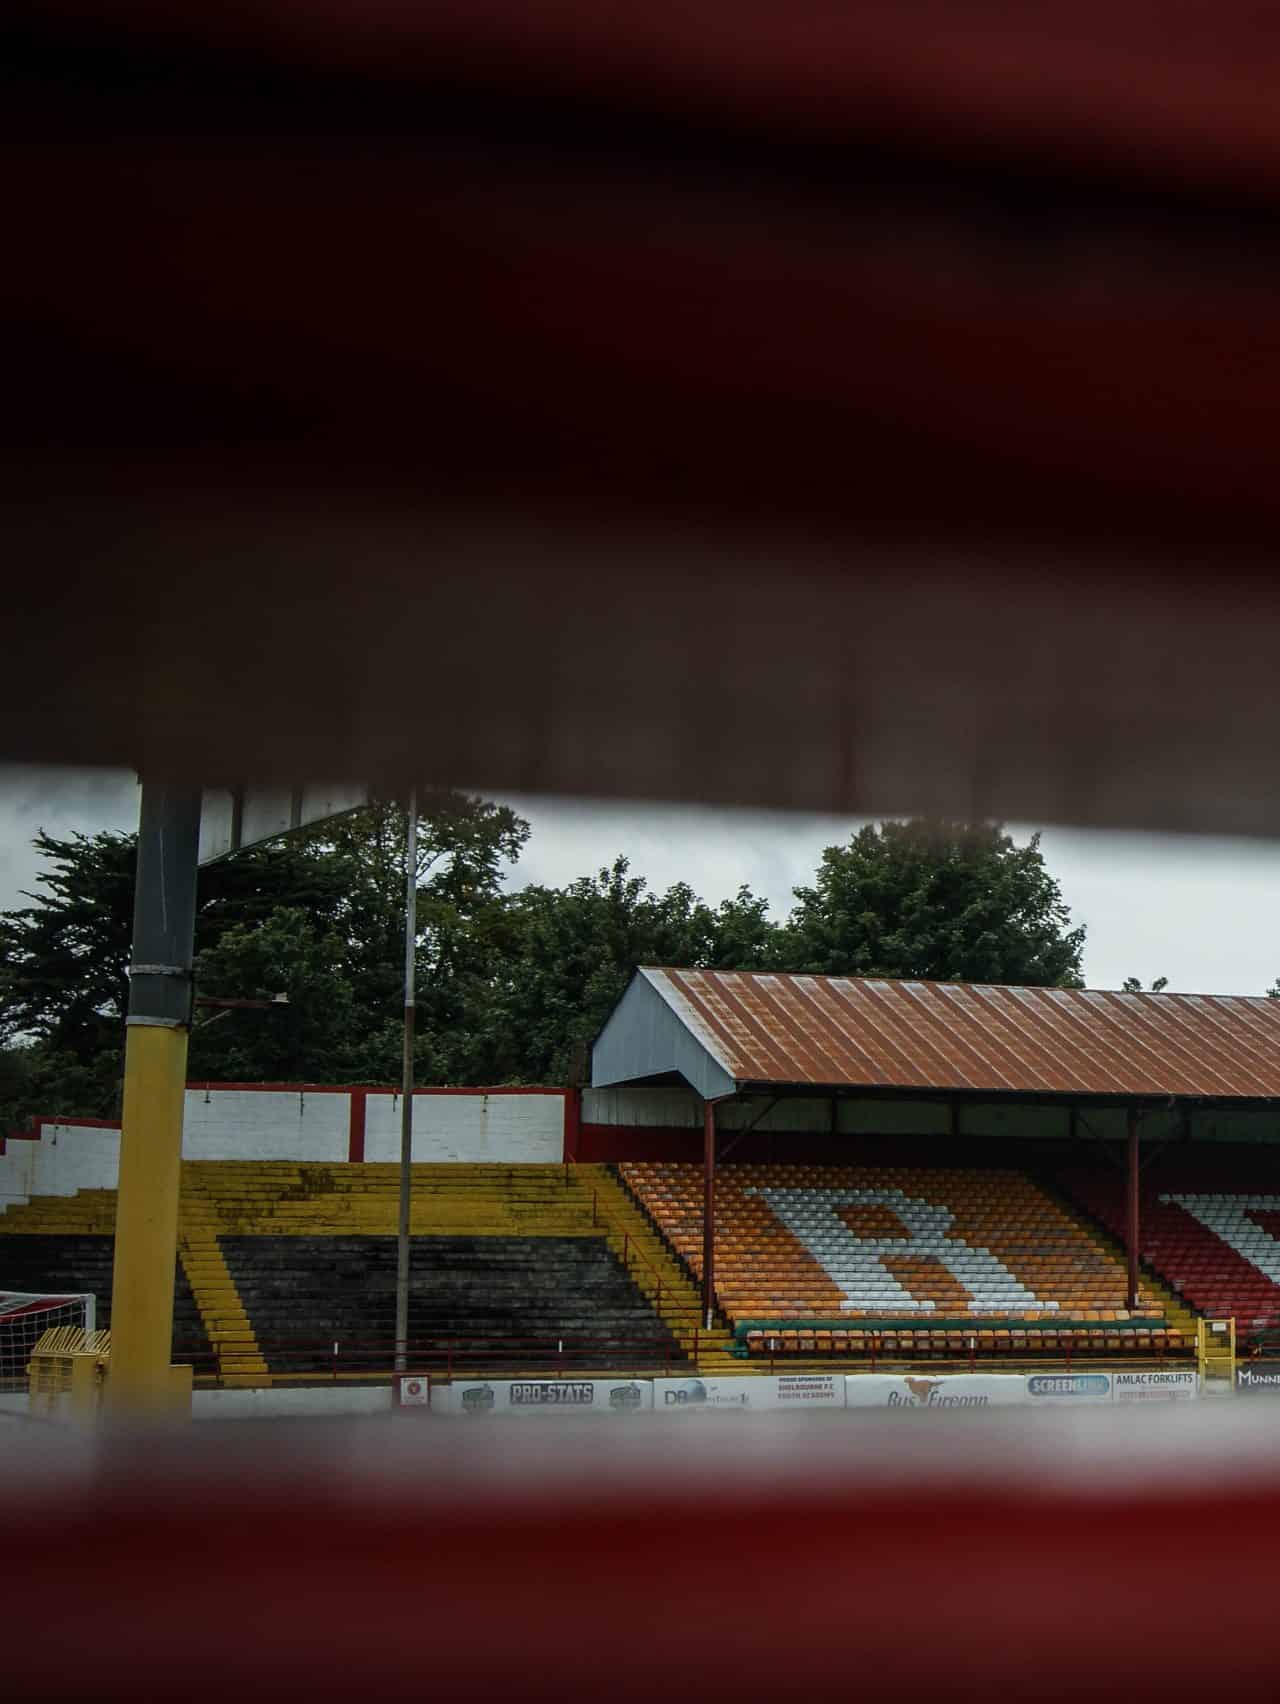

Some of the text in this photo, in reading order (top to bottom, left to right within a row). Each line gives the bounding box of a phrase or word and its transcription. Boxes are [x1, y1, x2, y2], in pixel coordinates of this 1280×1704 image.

[1116, 1374, 1193, 1385] AMLAC FORKLIFTS
[511, 1384, 593, 1402] PRO-STATS
